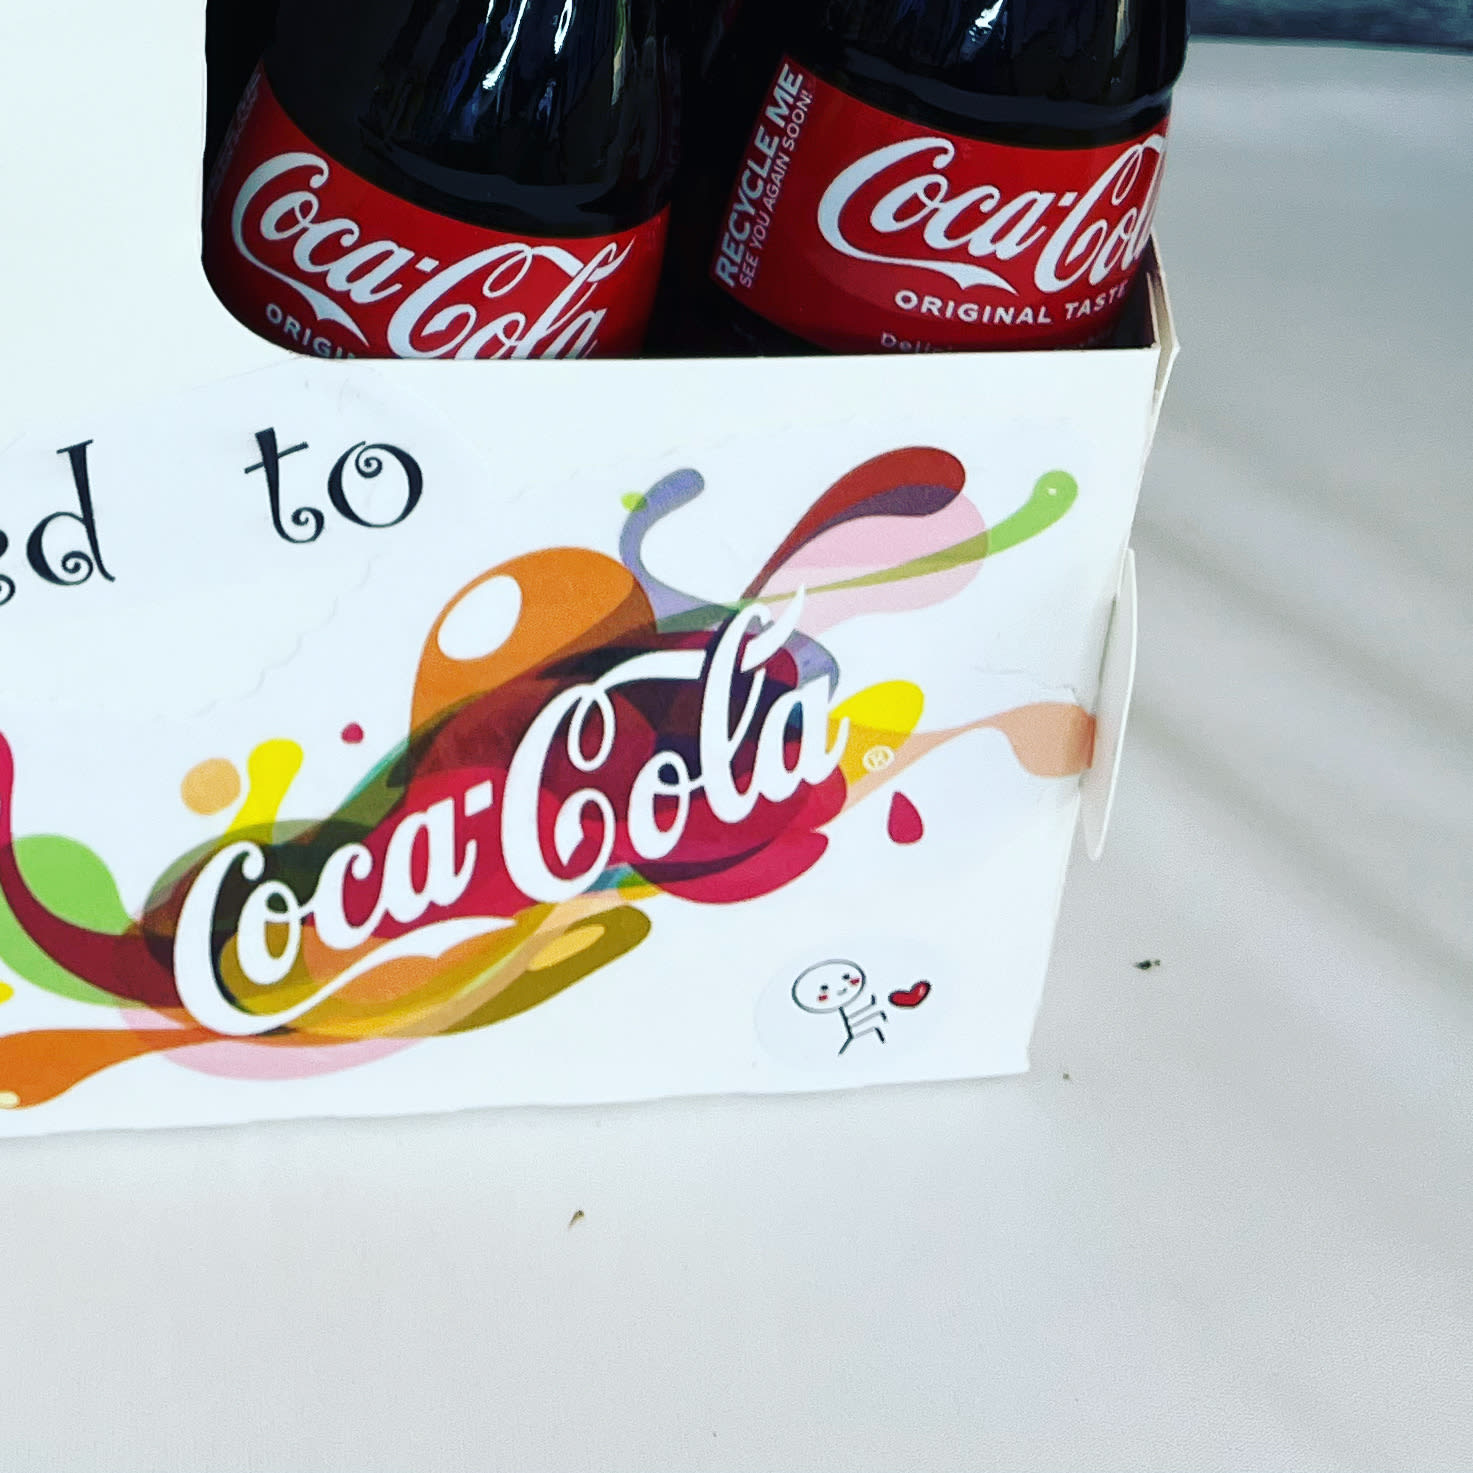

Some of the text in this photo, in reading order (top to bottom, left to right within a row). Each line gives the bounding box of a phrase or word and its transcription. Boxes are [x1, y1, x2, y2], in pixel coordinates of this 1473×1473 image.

[231, 151, 637, 360] Coca-Cola
[715, 63, 804, 288] RECYCLE ME
[739, 88, 814, 289] SEE YOU AGAIN SOON!
[894, 289, 1052, 326] ORIGINAL
[243, 426, 424, 544] to
[173, 584, 850, 1036] Coca-Cola
